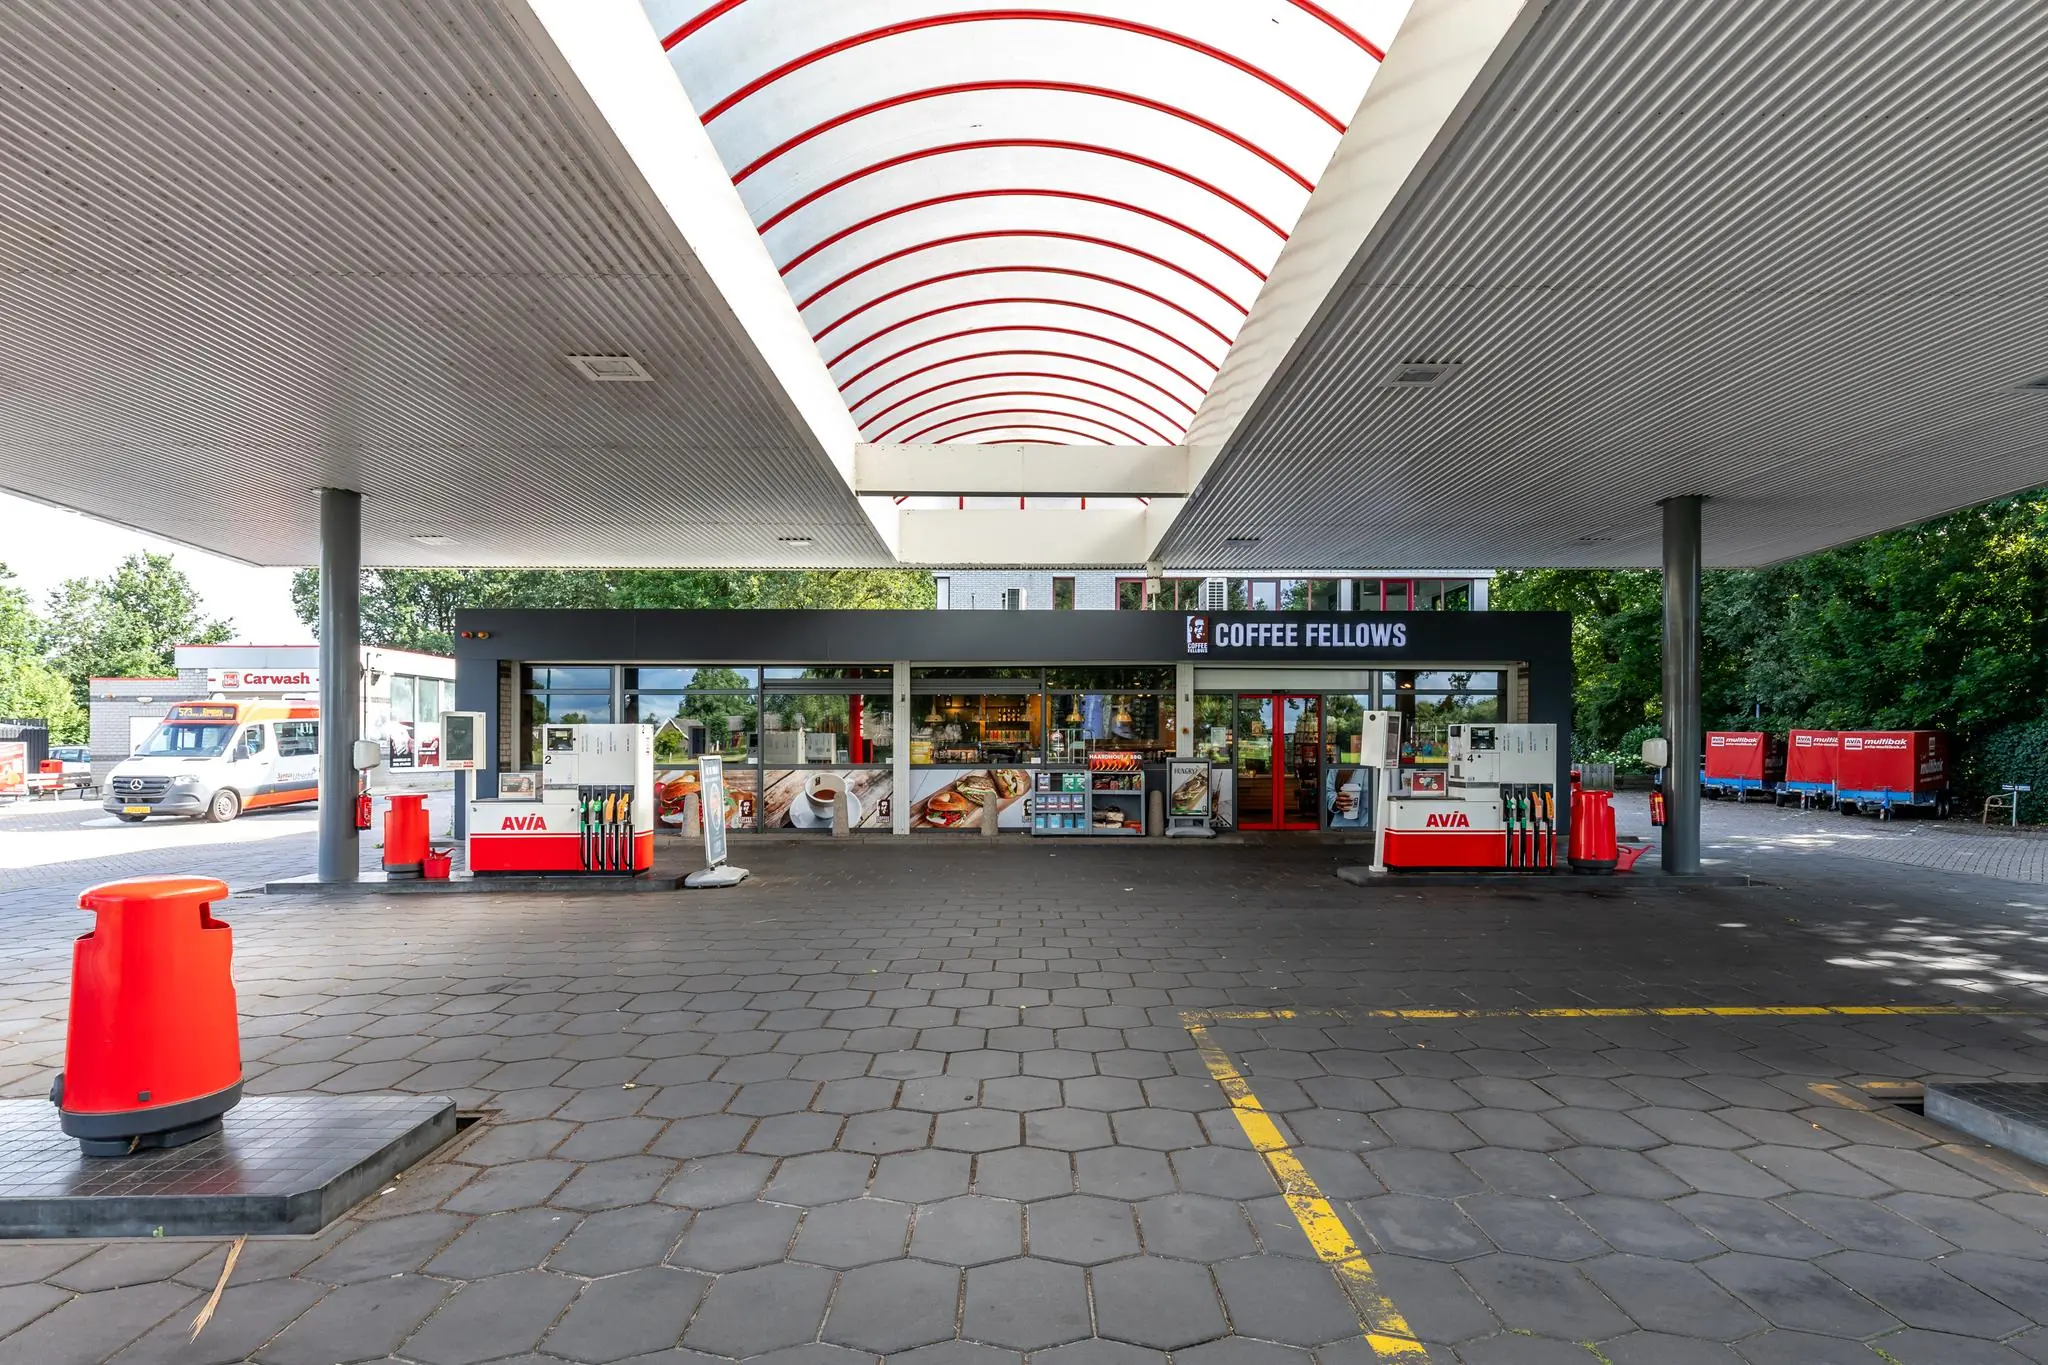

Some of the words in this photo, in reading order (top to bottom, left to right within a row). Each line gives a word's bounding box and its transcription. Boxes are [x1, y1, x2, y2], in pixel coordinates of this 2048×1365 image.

[1215, 622, 1298, 647] COFFEE
[1306, 622, 1406, 647] FELLOWS
[243, 671, 311, 685] Carwash
[544, 755, 552, 764] 2
[1467, 754, 1474, 763] 4
[501, 813, 547, 830] AVIA
[1426, 811, 1470, 827] AVIA
